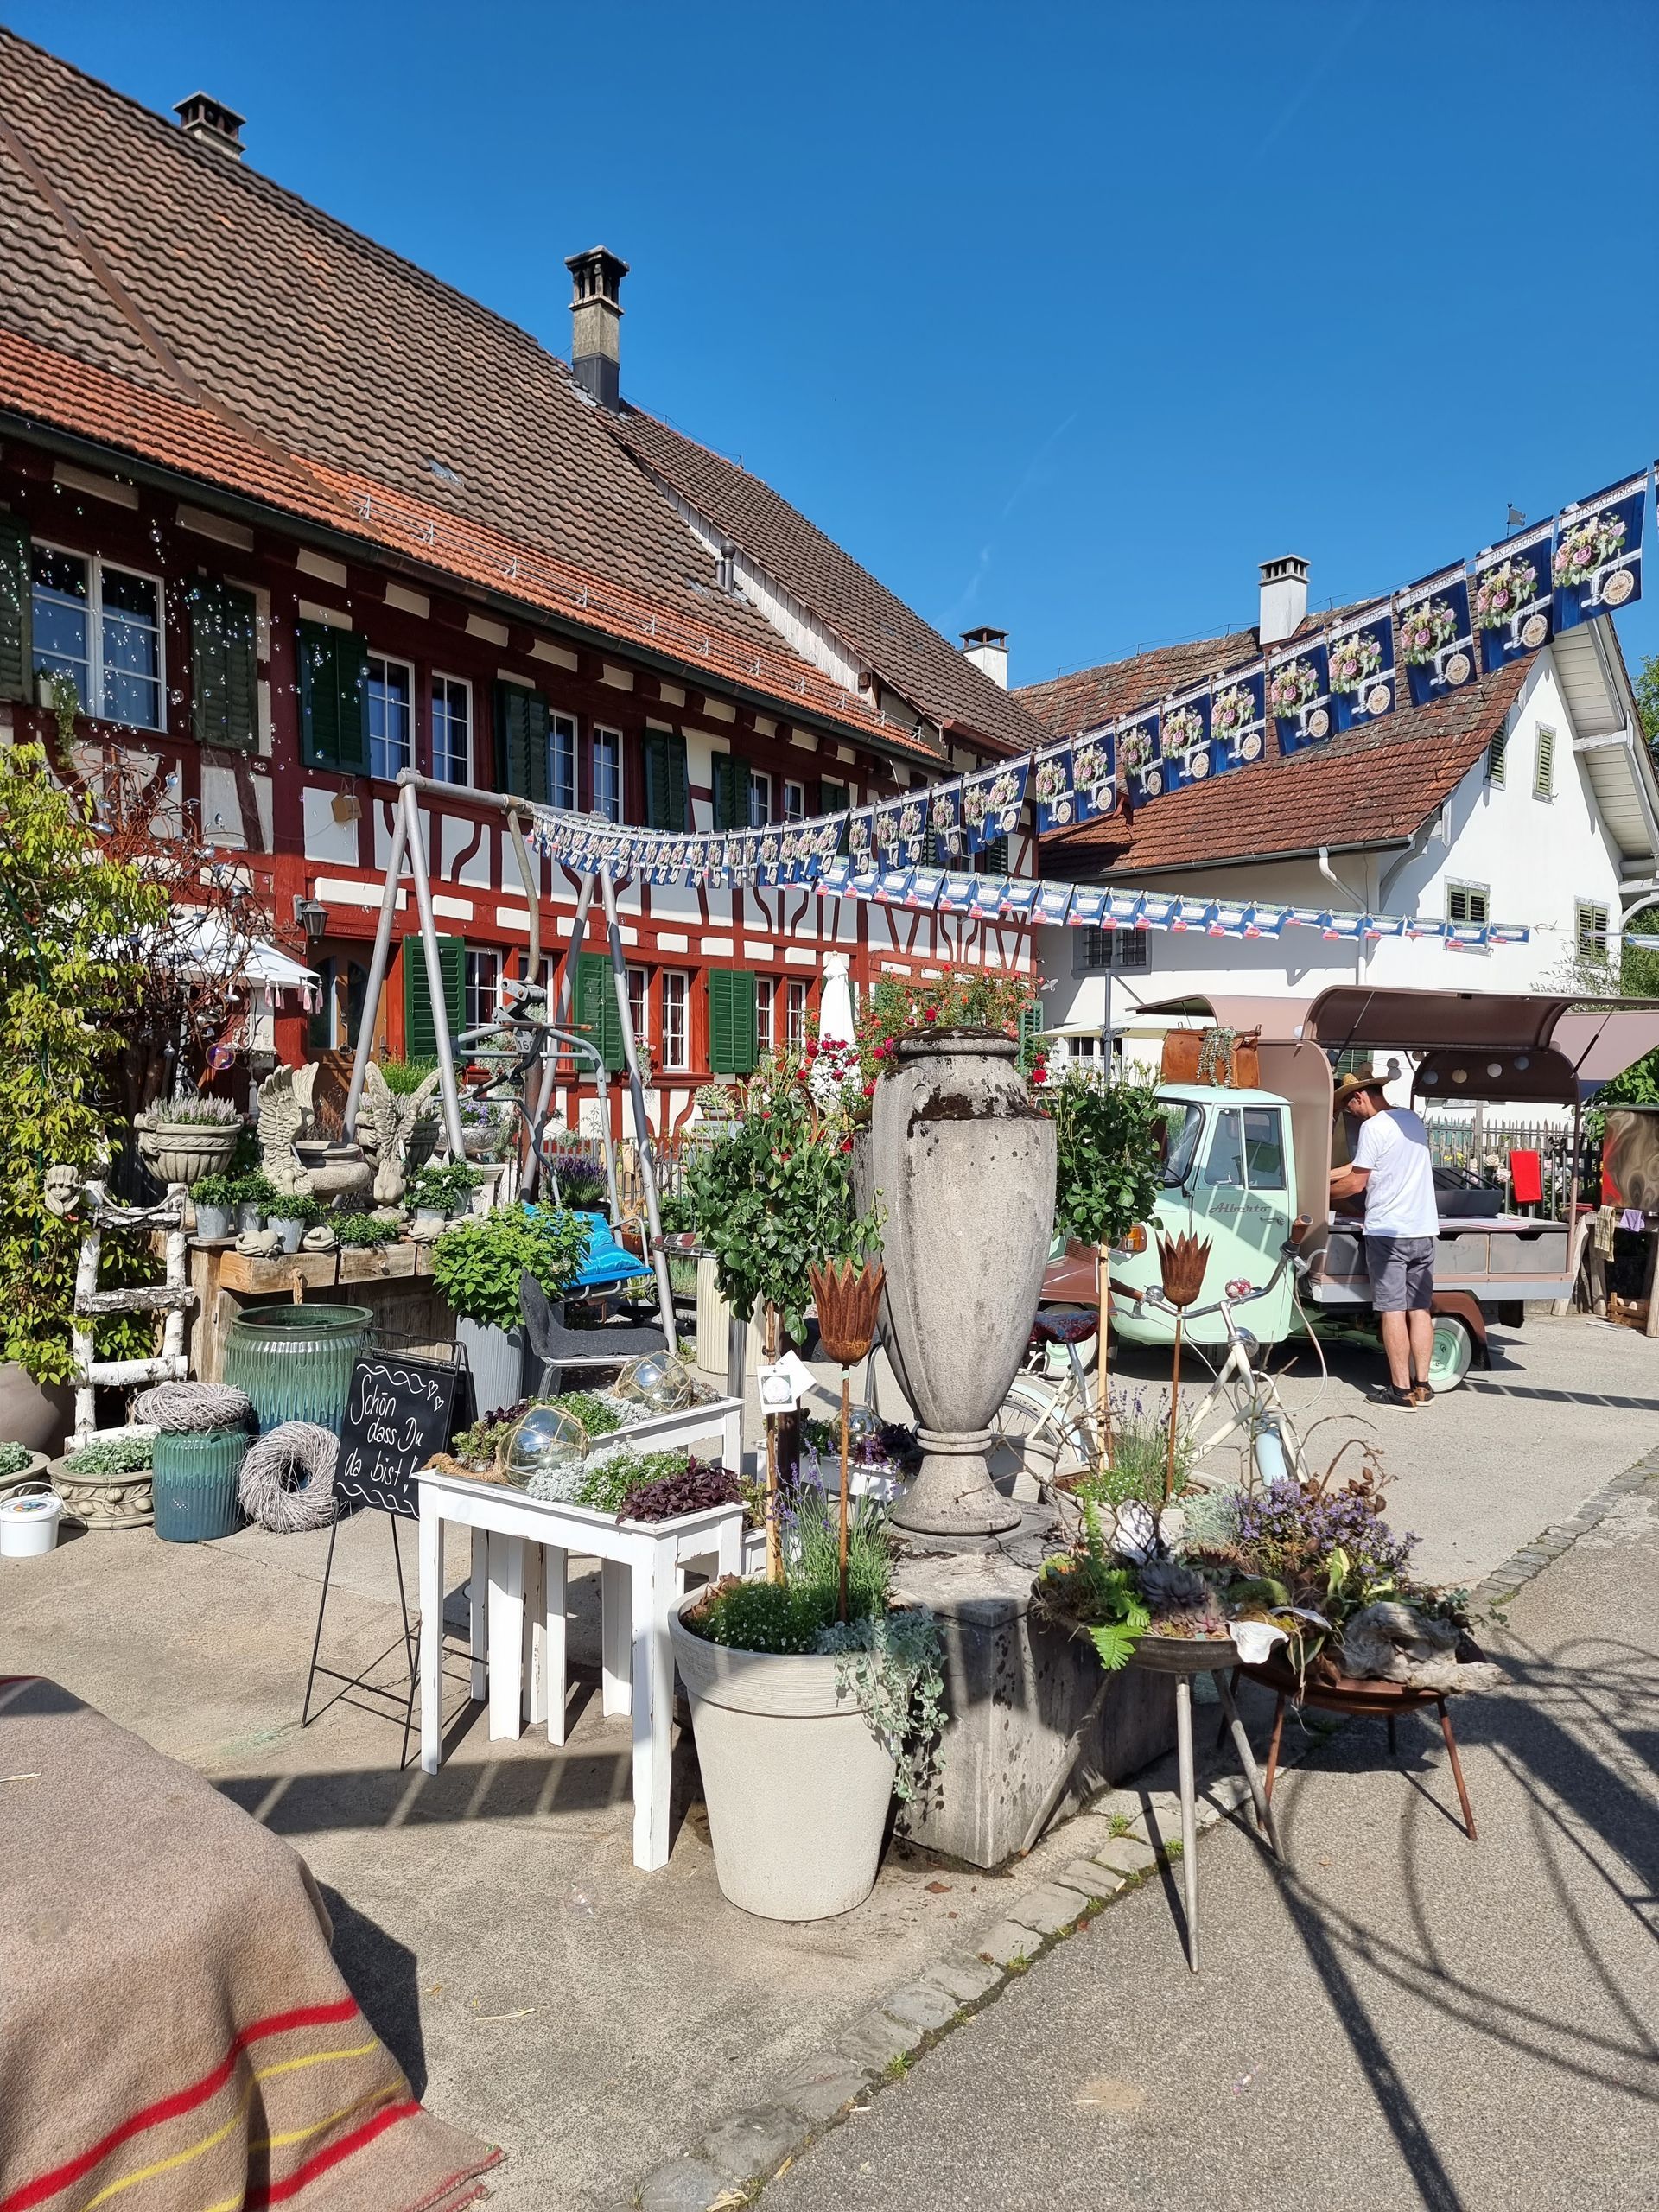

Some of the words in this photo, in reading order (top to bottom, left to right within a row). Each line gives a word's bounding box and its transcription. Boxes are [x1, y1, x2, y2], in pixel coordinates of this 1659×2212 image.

[1574, 485, 1634, 520] EINLADUNG
[1489, 531, 1541, 563] EINLADUNG
[1408, 574, 1456, 603] EINLADUNG
[1209, 1202, 1272, 1213] Alberto
[350, 1374, 397, 1425] Schön
[367, 1417, 397, 1444] dass
[397, 1417, 423, 1452] Du
[345, 1447, 362, 1477] da
